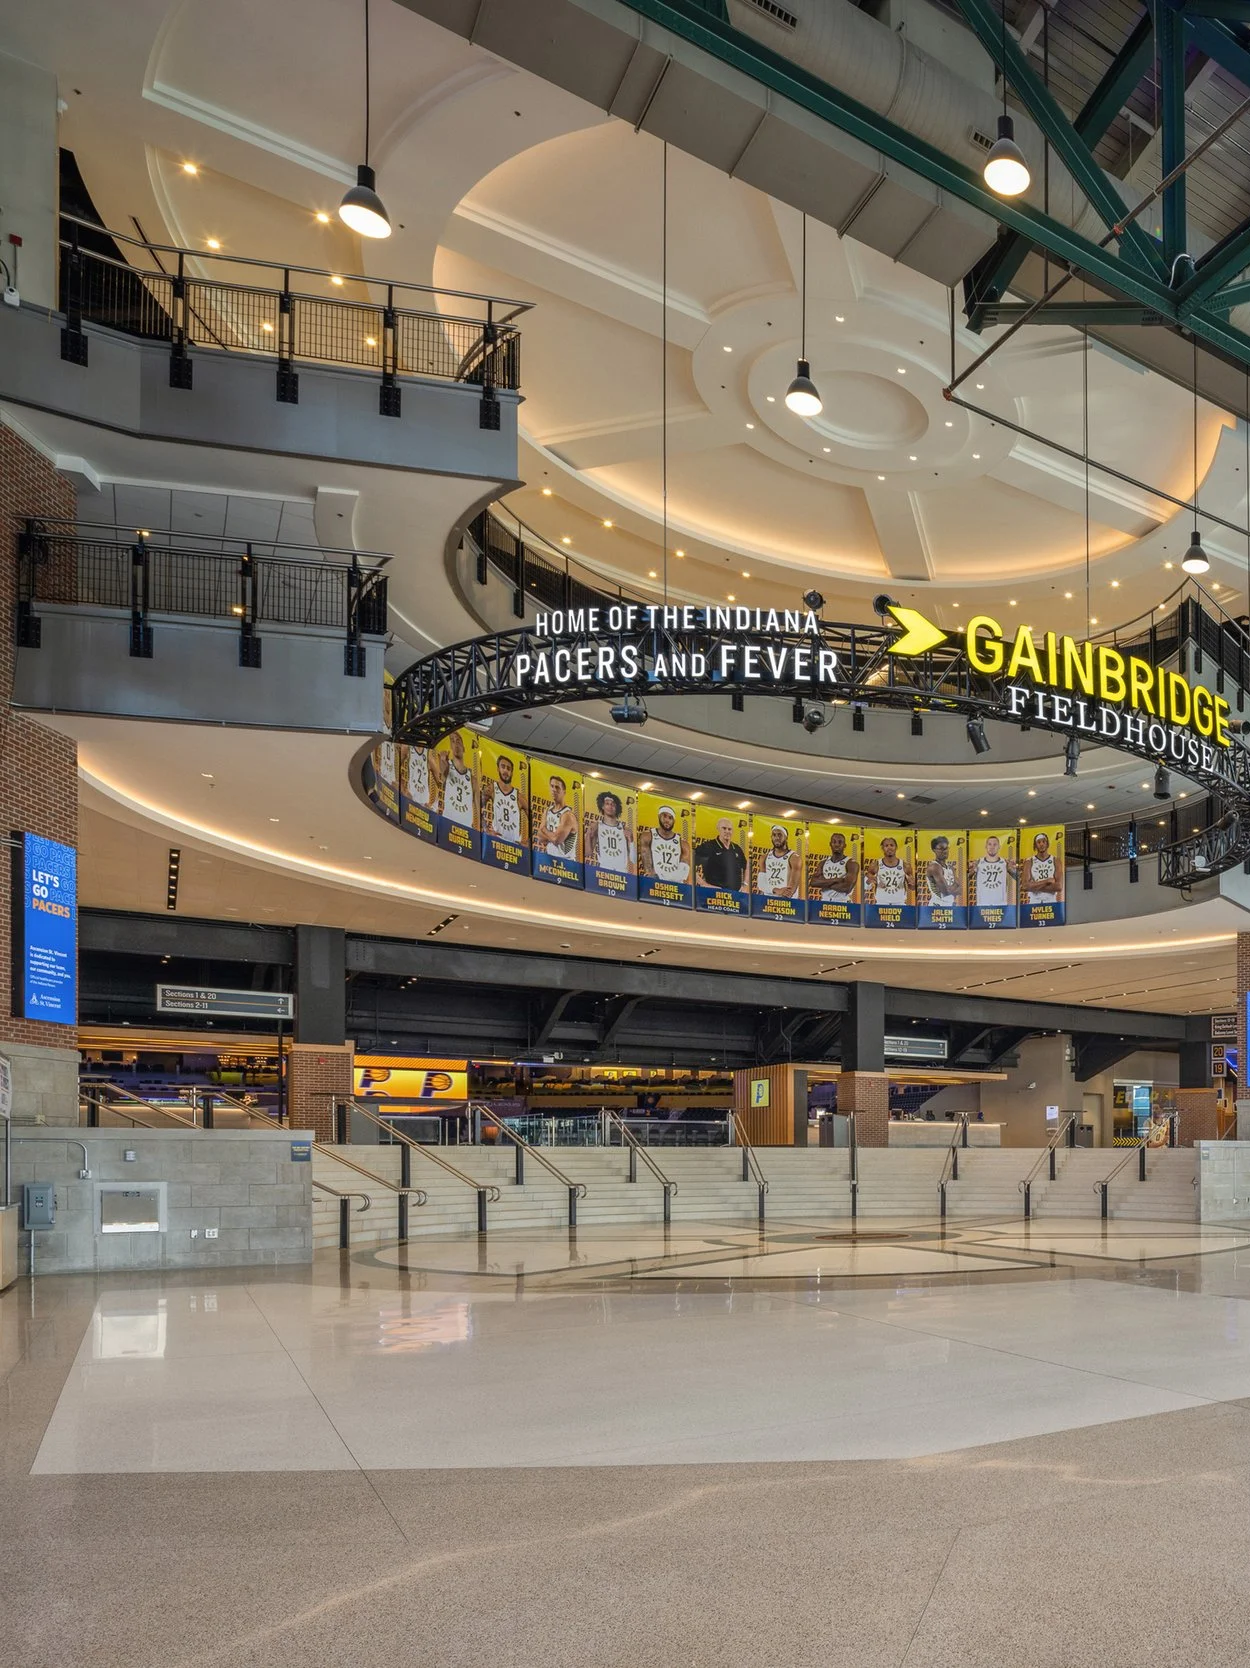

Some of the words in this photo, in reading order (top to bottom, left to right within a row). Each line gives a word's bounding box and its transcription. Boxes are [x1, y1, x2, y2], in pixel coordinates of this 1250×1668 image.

[535, 607, 600, 636] HOME
[609, 605, 638, 631] OF
[646, 604, 696, 630] THE
[705, 605, 820, 635] INDIANA
[515, 645, 639, 687] PACERS
[653, 653, 706, 679] AND
[720, 645, 838, 683] FEVER
[966, 615, 1231, 747] GAINBRIDGE
[1007, 685, 1215, 773] FIELDHOUSE
[456, 786, 463, 803] 3
[503, 807, 510, 822] 8
[451, 825, 469, 839] CHRIS
[448, 832, 472, 849] DUARTE
[608, 837, 617, 850] 10
[458, 846, 462, 854] 3
[491, 840, 523, 857] TREVELIN
[496, 850, 518, 864] QUEEN
[662, 852, 672, 865] 12
[553, 860, 566, 870] T.J.
[981, 864, 1003, 874] INDIANA
[32, 869, 60, 888] LET'S
[595, 871, 628, 884] KENDALL
[770, 868, 781, 879] 22
[986, 871, 998, 882] 27
[1038, 869, 1049, 879] 33
[556, 877, 562, 885] 9
[598, 878, 626, 891] BROWN
[885, 876, 898, 888] 24
[32, 883, 48, 899] GO
[608, 889, 616, 897] 10
[654, 882, 679, 893] OSHAE
[649, 889, 684, 901] BRISSETT
[715, 891, 733, 900] RICK
[32, 897, 71, 918] PACERS
[706, 898, 740, 909] CARLISLE
[767, 899, 791, 908] ISAIAH
[822, 904, 848, 912] AARON
[762, 906, 796, 915] JACKSON
[818, 910, 851, 920] NESMITH
[878, 907, 902, 915] BUDDY
[980, 908, 1004, 916] DANIEL
[1031, 905, 1053, 914] MYLES
[880, 914, 901, 922] HIELD
[1030, 912, 1055, 920] TURNER
[165, 989, 194, 999] Sections
[165, 1000, 194, 1008] Sections
[1213, 1046, 1223, 1057] 20
[1214, 1063, 1223, 1073] 19
